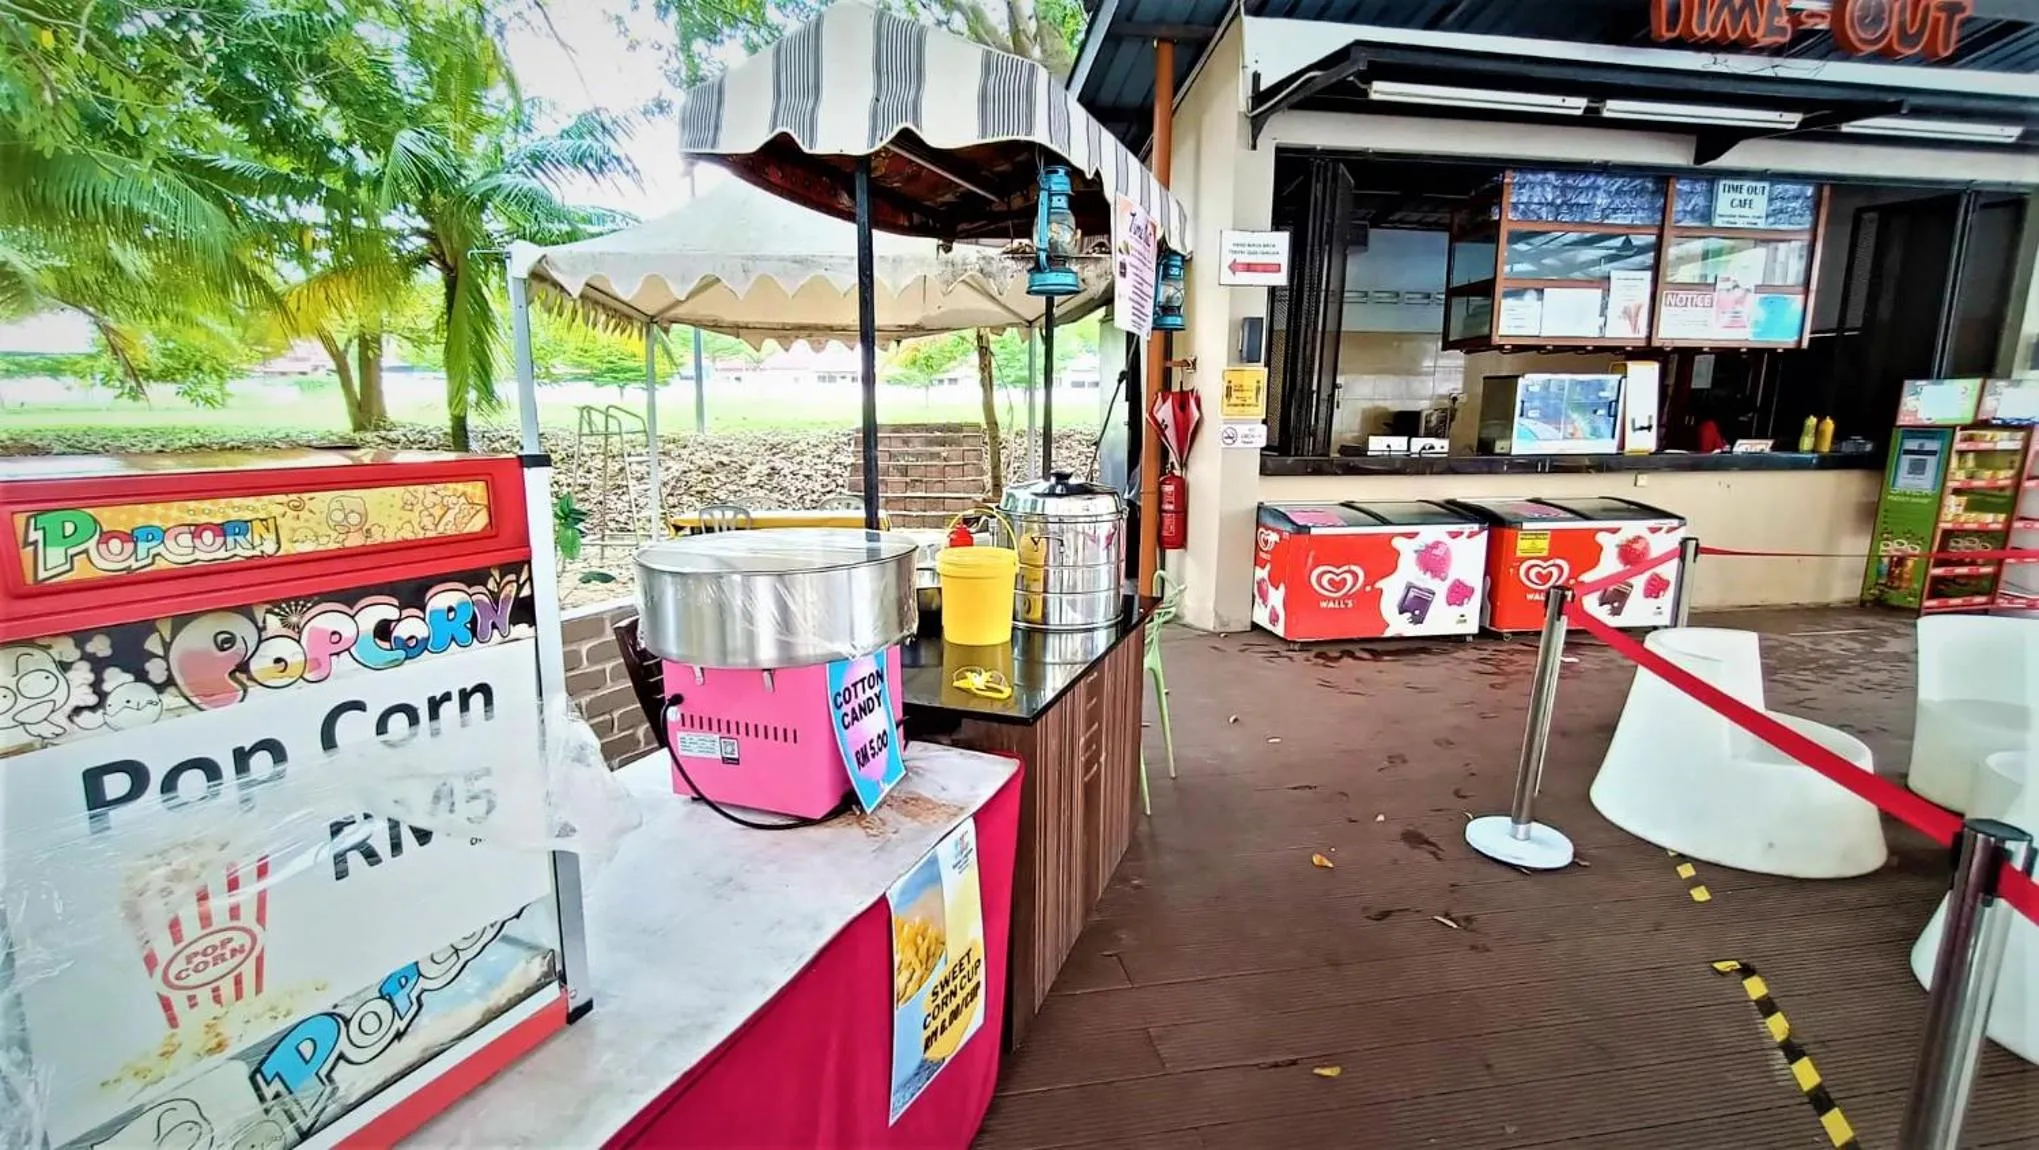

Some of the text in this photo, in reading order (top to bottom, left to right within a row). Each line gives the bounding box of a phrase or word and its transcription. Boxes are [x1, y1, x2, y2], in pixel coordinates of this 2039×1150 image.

[1722, 183, 1767, 196] TIME OUT
[1665, 293, 1713, 307] NOTICE
[24, 508, 281, 584] POPCORN
[168, 573, 518, 711] POPCORN
[833, 667, 884, 710] COTTON
[841, 689, 882, 730] CANDY
[82, 681, 496, 836] Pop Corn
[854, 729, 889, 772] RM 5.00
[175, 943, 246, 981] CORN
[186, 937, 234, 965] POP
[923, 958, 981, 1031] CORN CUP
[931, 947, 972, 1003] SWEET
